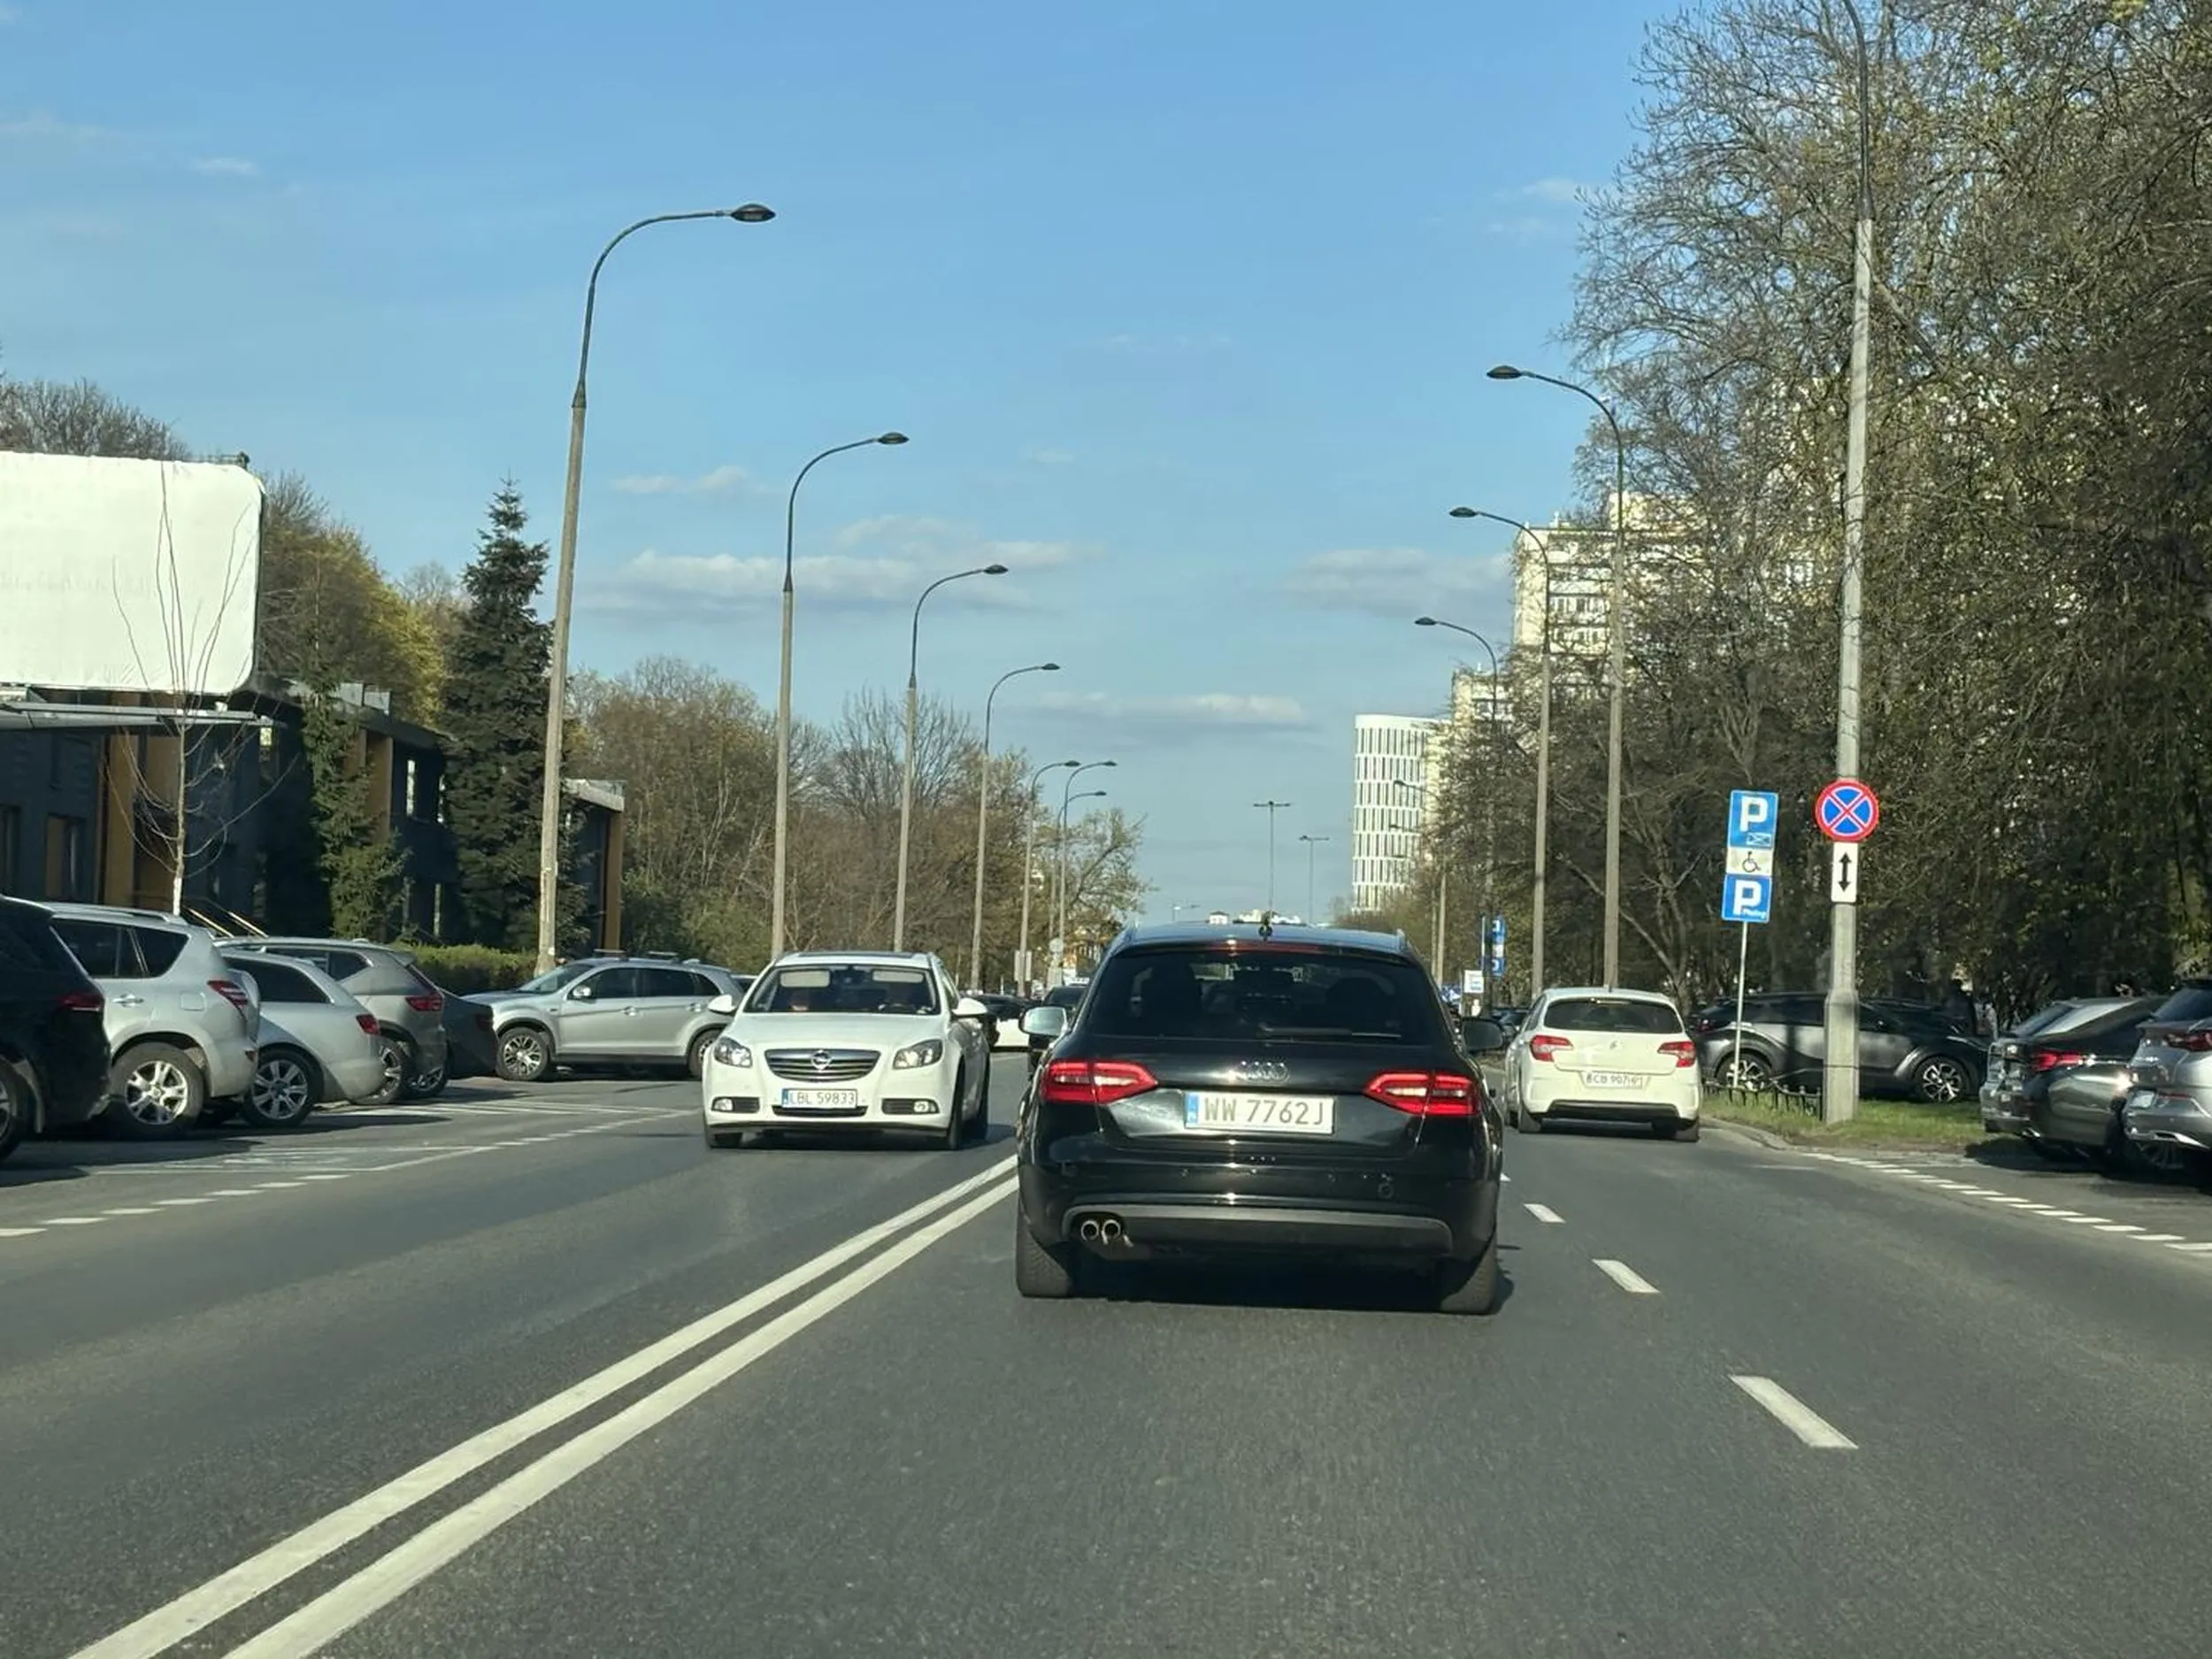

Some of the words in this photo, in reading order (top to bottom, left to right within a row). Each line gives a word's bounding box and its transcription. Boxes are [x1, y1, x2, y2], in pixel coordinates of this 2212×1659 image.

[1740, 796, 1768, 832] P
[1733, 879, 1762, 915] P
[791, 1092, 811, 1105] LBL
[817, 1092, 855, 1105] 59833
[1204, 1097, 1237, 1122] WW
[1247, 1099, 1324, 1125] 7762J
